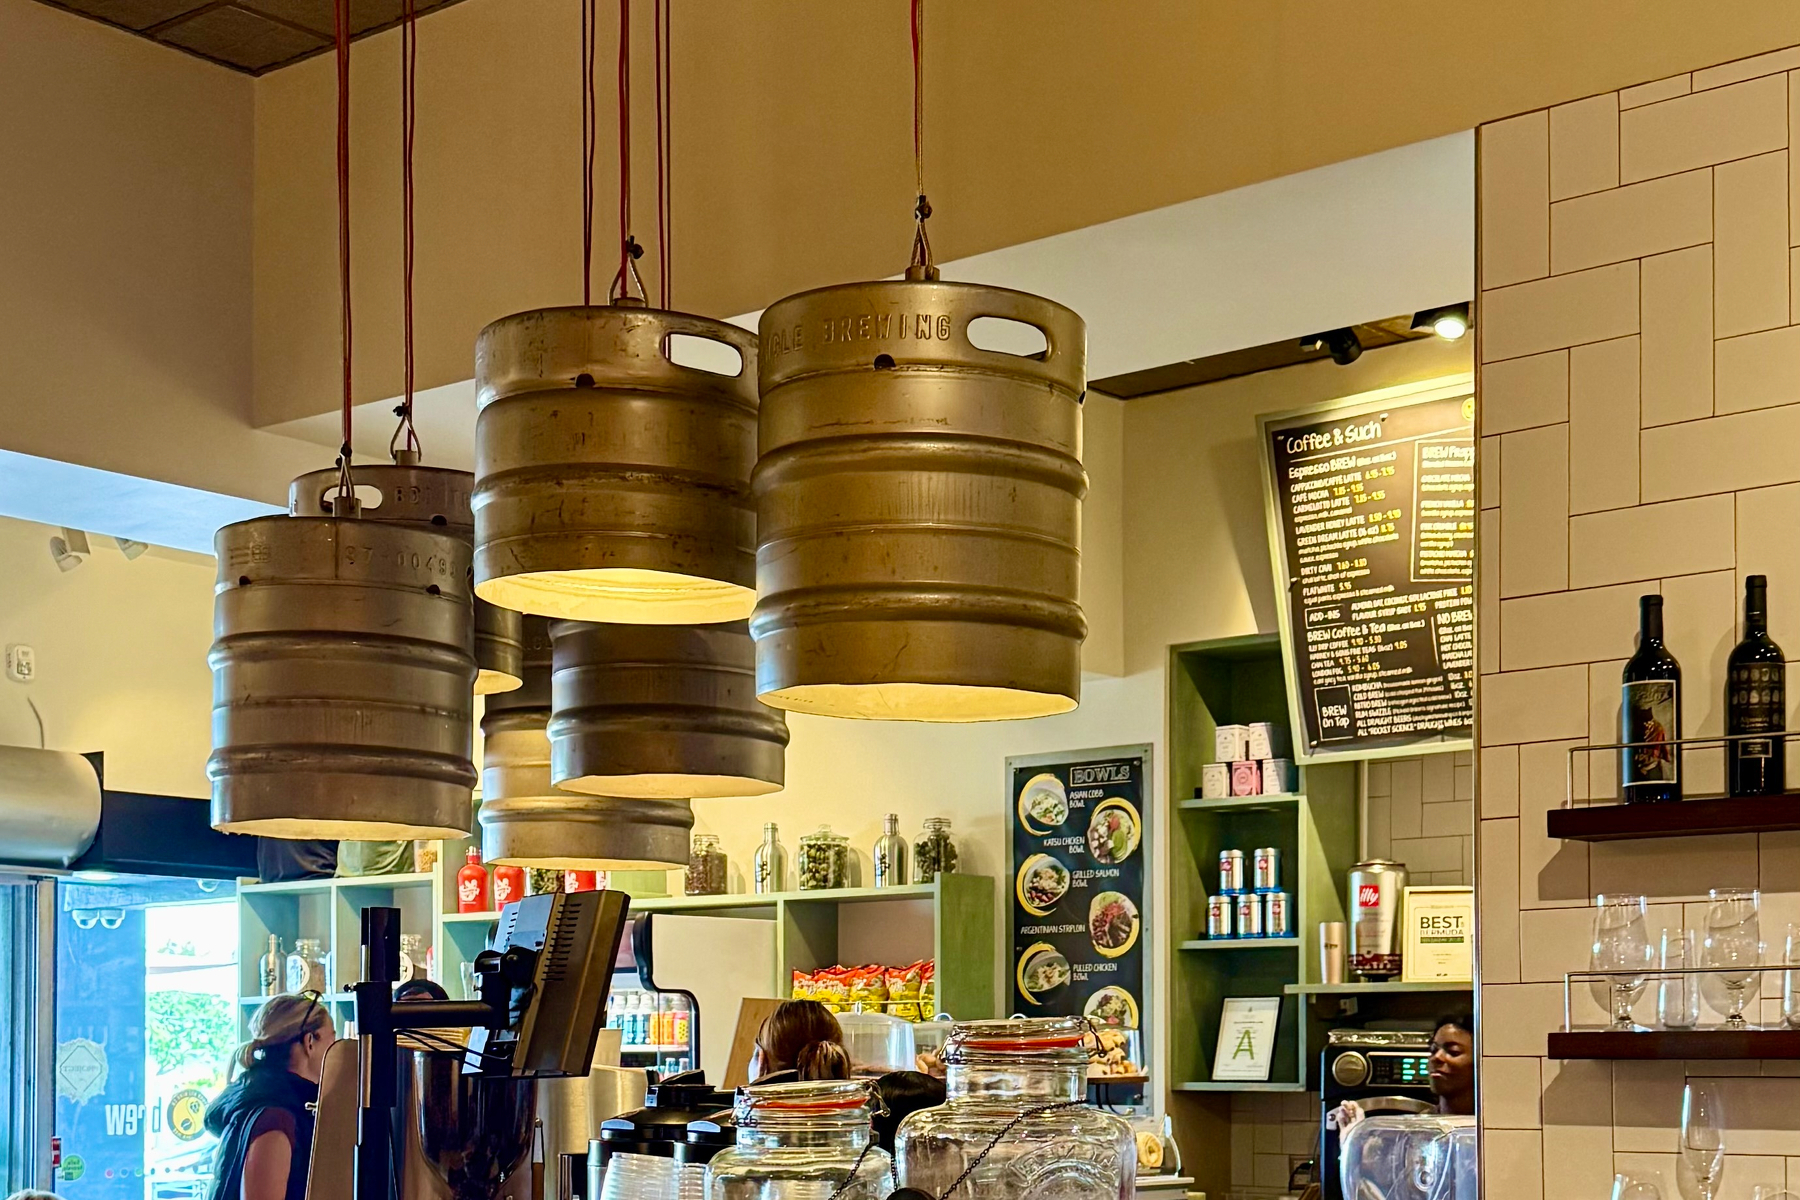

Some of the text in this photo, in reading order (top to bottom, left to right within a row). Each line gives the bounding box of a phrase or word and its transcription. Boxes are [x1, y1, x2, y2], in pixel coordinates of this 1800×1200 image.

[823, 315, 951, 345] BREWING
[1287, 421, 1382, 454] Coffee & Such
[1289, 463, 1330, 480] Espresso
[1330, 456, 1356, 472] BREW
[1331, 497, 1350, 508] LATTE
[1345, 515, 1365, 527] LATTE
[1297, 535, 1317, 547] GREEN
[1339, 529, 1358, 540] LATTE
[1300, 566, 1317, 576] DIRTY
[1318, 563, 1332, 573] CHAI
[1437, 613, 1450, 624] NO
[1307, 629, 1331, 642] BREW
[1331, 626, 1361, 638] Coffee
[1369, 622, 1386, 633] Tea
[1329, 640, 1349, 650] COFFEE
[1324, 659, 1334, 668] TEA
[1368, 690, 1384, 699] BREW
[1371, 699, 1387, 707] BREW
[1322, 704, 1347, 717] BREW
[1323, 716, 1350, 728] On Tap
[1357, 720, 1367, 728] ALL
[1367, 716, 1393, 726] DRAUGHT
[1358, 729, 1368, 737] ALL
[1073, 765, 1130, 784] BOWLS
[1069, 789, 1104, 800] ASIAN COBB
[1069, 800, 1085, 809] BOWL
[1043, 836, 1085, 847] KATSU CHICKEN
[1069, 845, 1085, 854] BOWL
[1072, 869, 1120, 879] GRILLED SALMON
[1072, 879, 1088, 888] BOWL
[1360, 887, 1379, 906] illy
[1420, 916, 1463, 929] BEST
[1021, 925, 1058, 934] ARGENTINIAN
[1073, 963, 1117, 972] PULLED CHICKEN
[1073, 973, 1089, 981] BOWL
[1232, 1029, 1254, 1060] A
